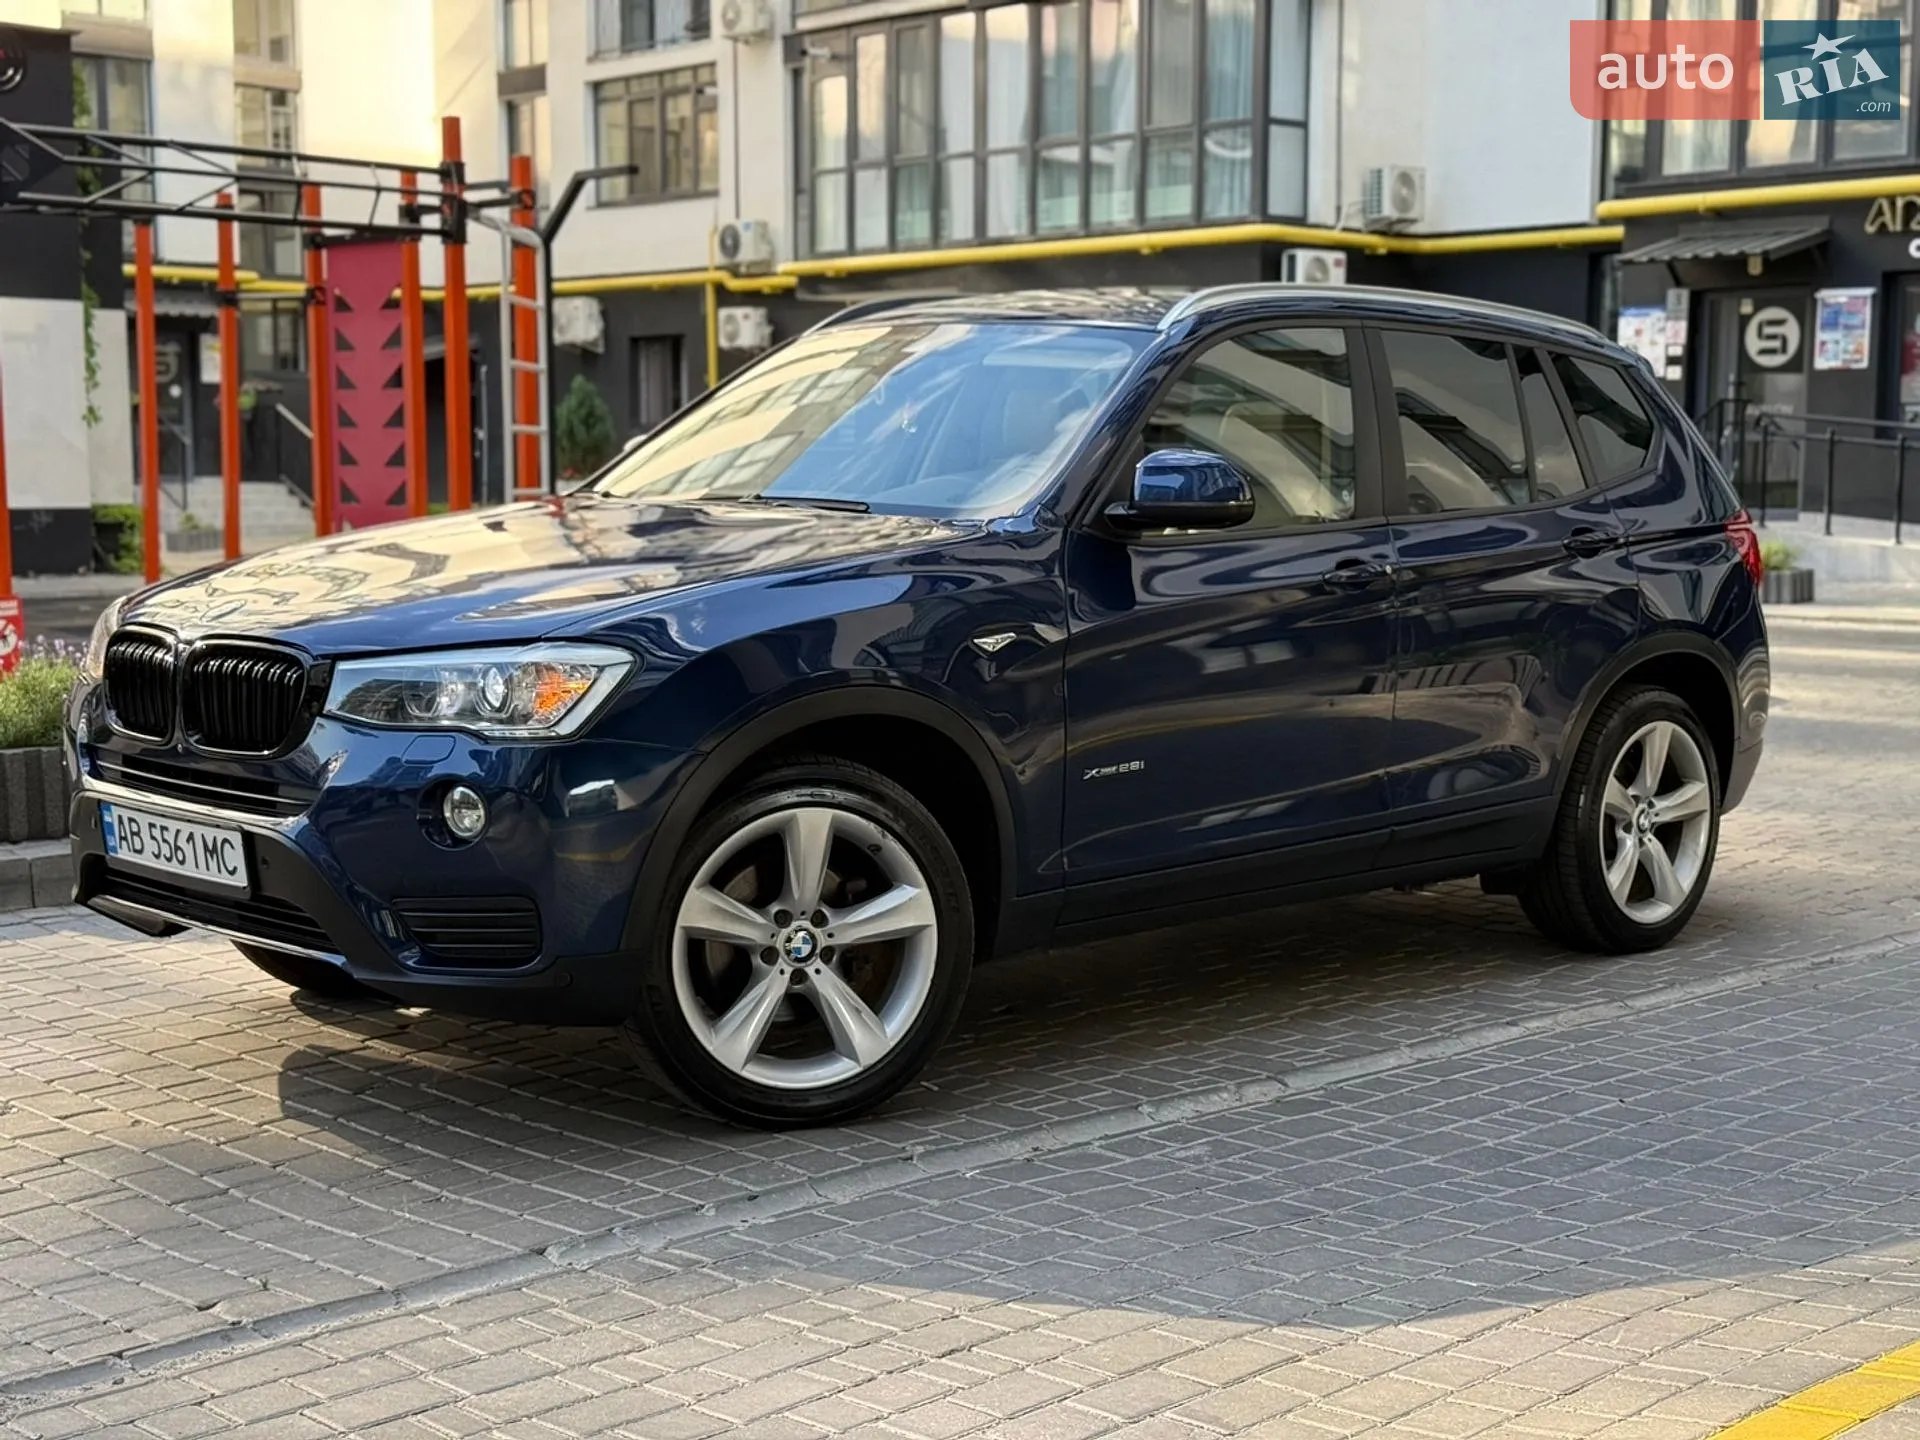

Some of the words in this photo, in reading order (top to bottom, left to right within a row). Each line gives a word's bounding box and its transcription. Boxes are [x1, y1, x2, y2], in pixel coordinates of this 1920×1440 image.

[117, 814, 145, 856] AB
[148, 822, 199, 870] 5561
[201, 832, 238, 876] MC
